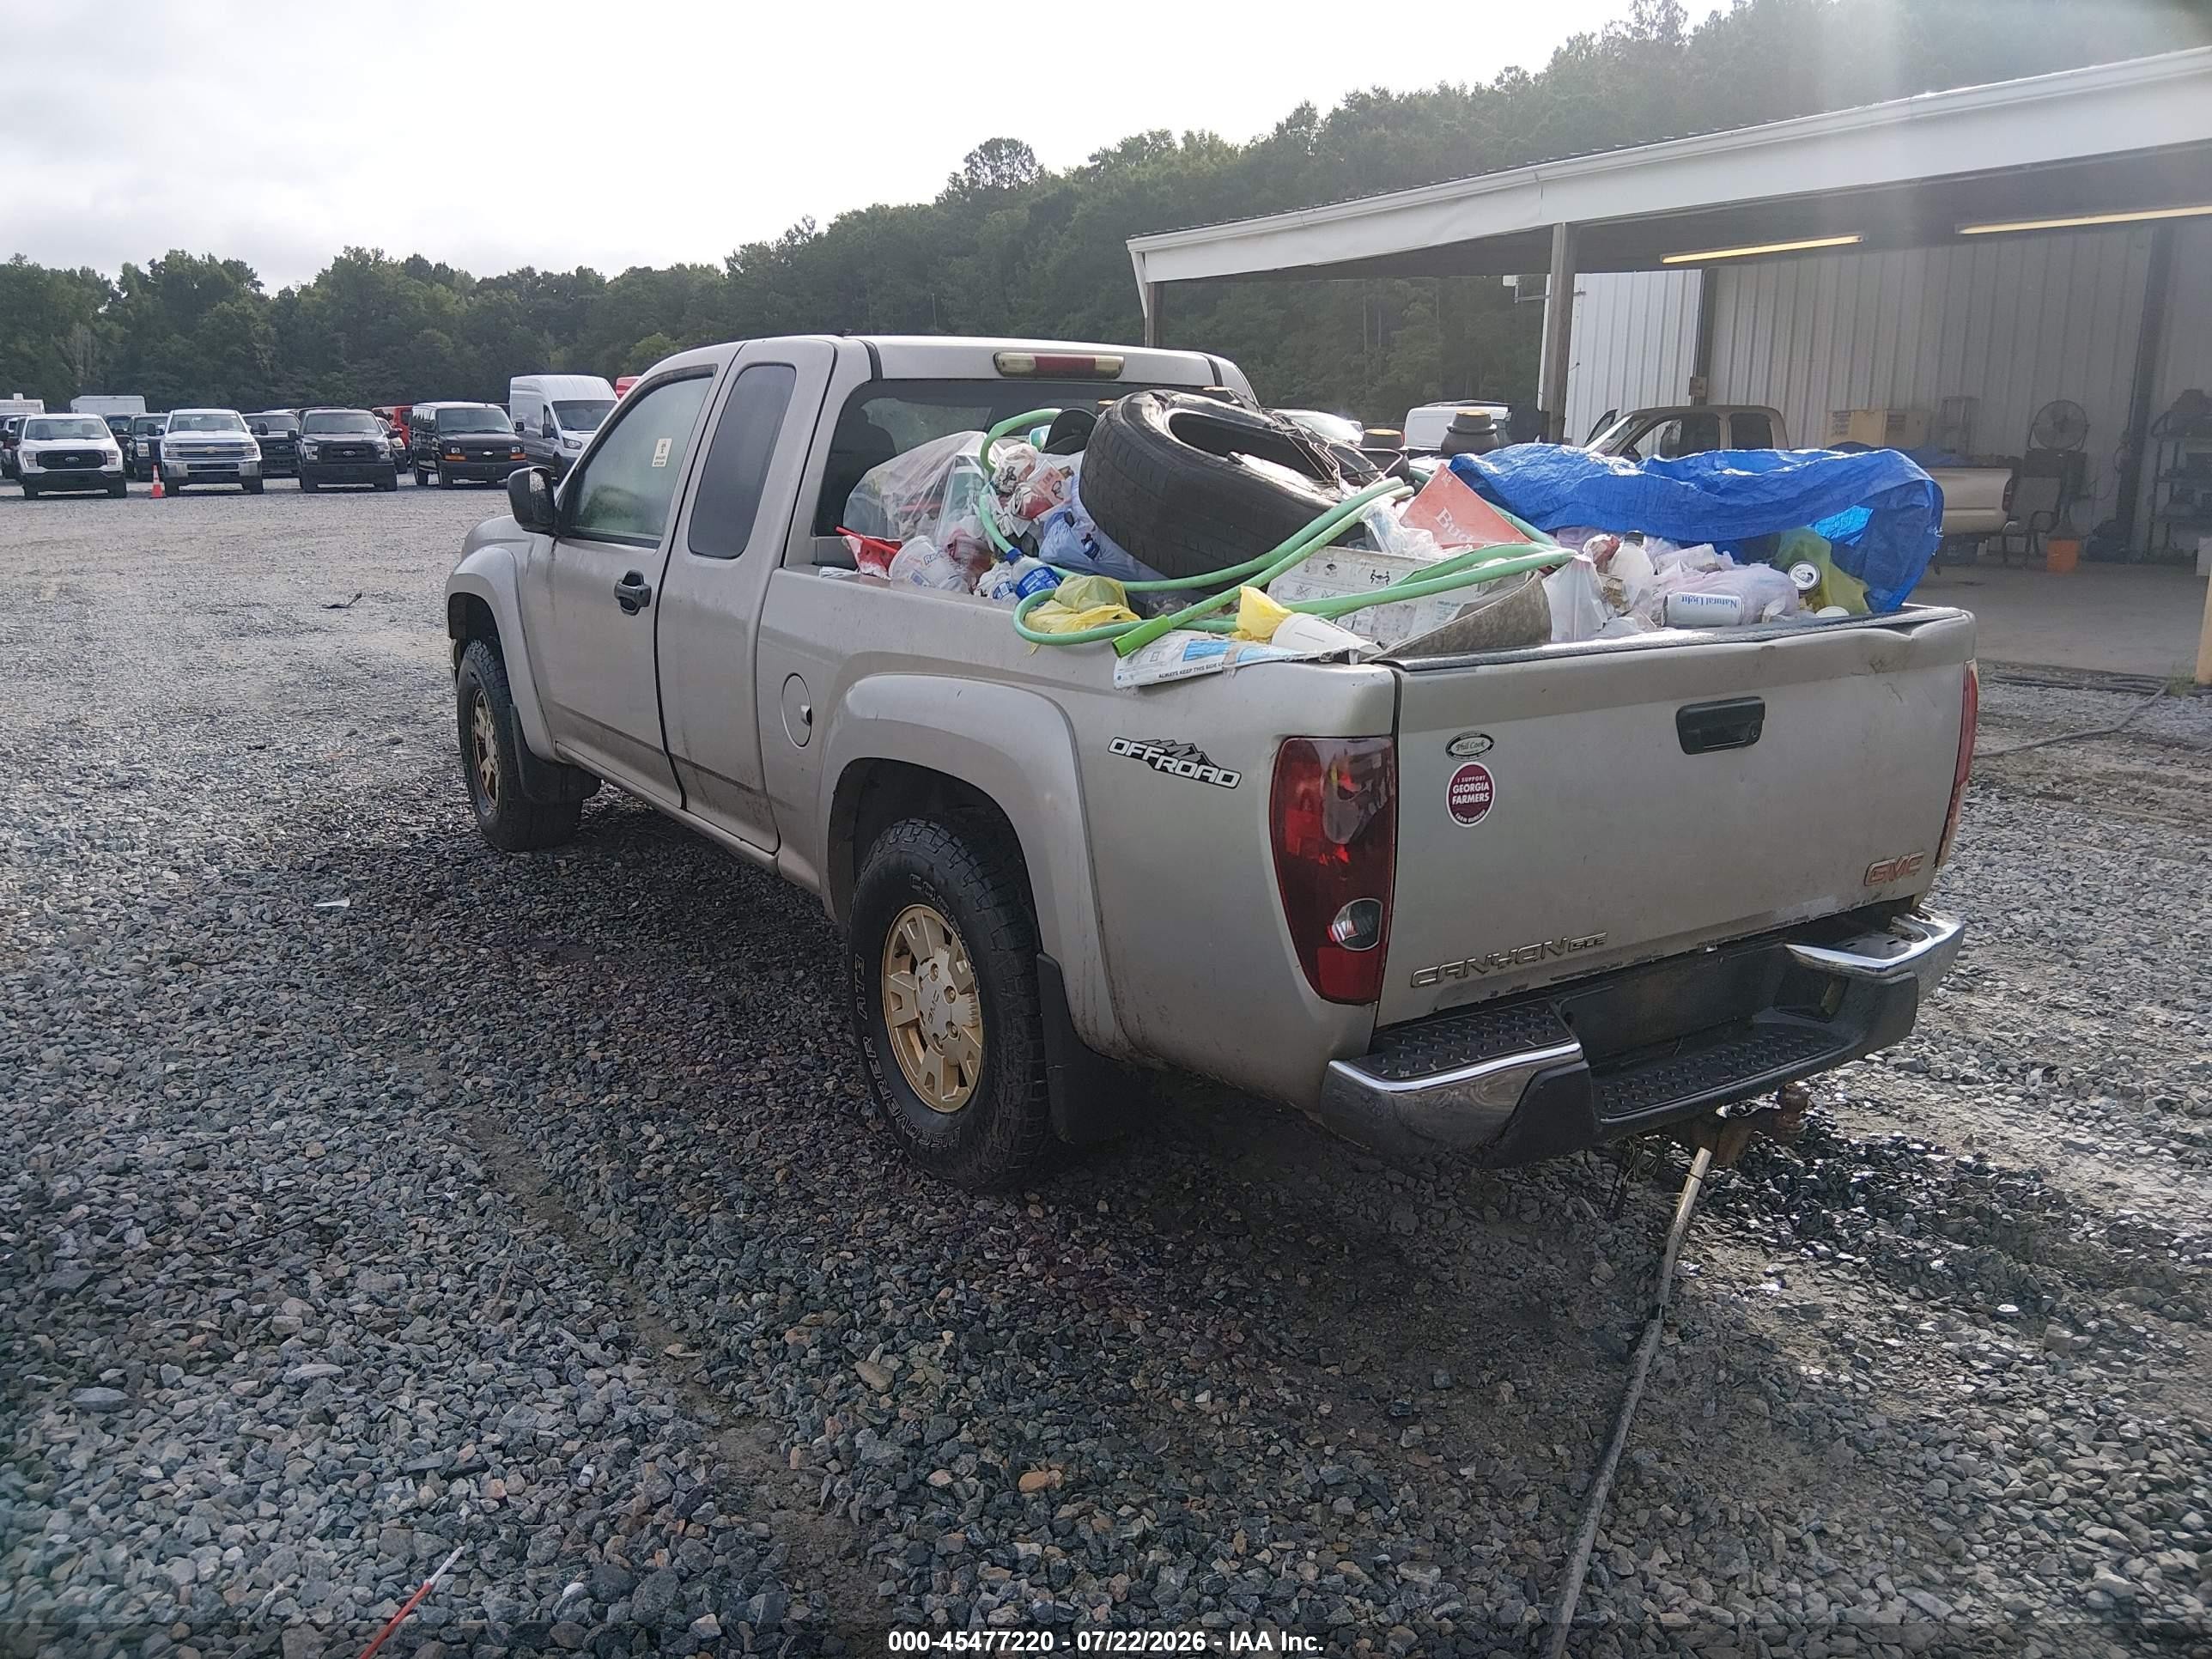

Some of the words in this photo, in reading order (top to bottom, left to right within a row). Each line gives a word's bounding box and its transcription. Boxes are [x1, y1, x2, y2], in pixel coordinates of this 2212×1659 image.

[1681, 594, 1704, 606] Light
[1706, 597, 1737, 609] Natural
[1158, 670, 1179, 679] ALWAYS
[1194, 665, 1205, 673] THIS
[1461, 775, 1486, 783] SUPPORT
[1452, 781, 1490, 794] GEORGIA
[1451, 792, 1491, 805] FARMERS
[1455, 811, 1468, 823] FARM
[1864, 851, 1924, 887] GMC
[1410, 936, 1569, 988] CANYON
